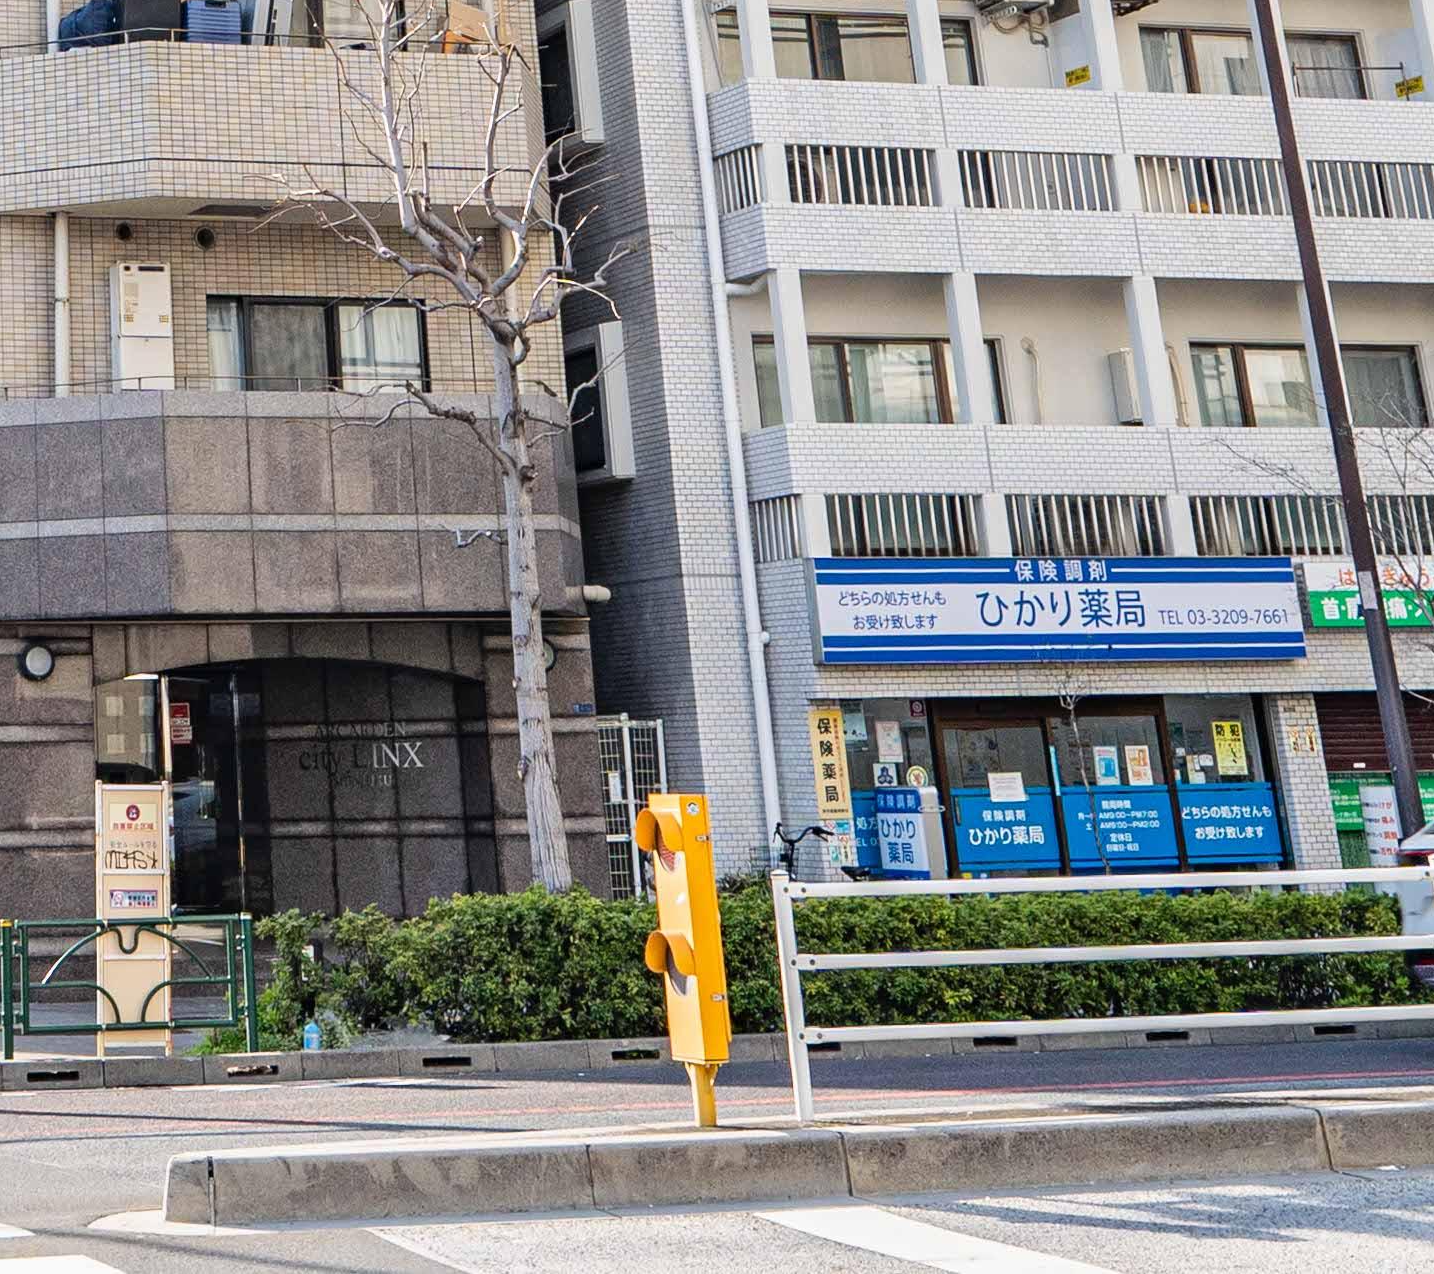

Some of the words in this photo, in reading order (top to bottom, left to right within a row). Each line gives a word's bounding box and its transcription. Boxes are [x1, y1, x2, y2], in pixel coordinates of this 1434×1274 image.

[1014, 559, 1108, 582] 保険調剤
[838, 590, 947, 606] どちらの処方せんも
[975, 588, 1147, 628] ひかり薬局
[853, 613, 939, 631] お受け致します
[1158, 609, 1184, 626] TEL
[1187, 607, 1289, 626] 03-3209-7661
[817, 717, 840, 804] 保険薬局
[1181, 805, 1273, 819] どちらの処方せんも
[880, 818, 917, 839] ひかり
[968, 825, 1045, 846] ひかり薬局
[1194, 825, 1264, 840] お受け致します
[887, 841, 915, 865] 薬局
